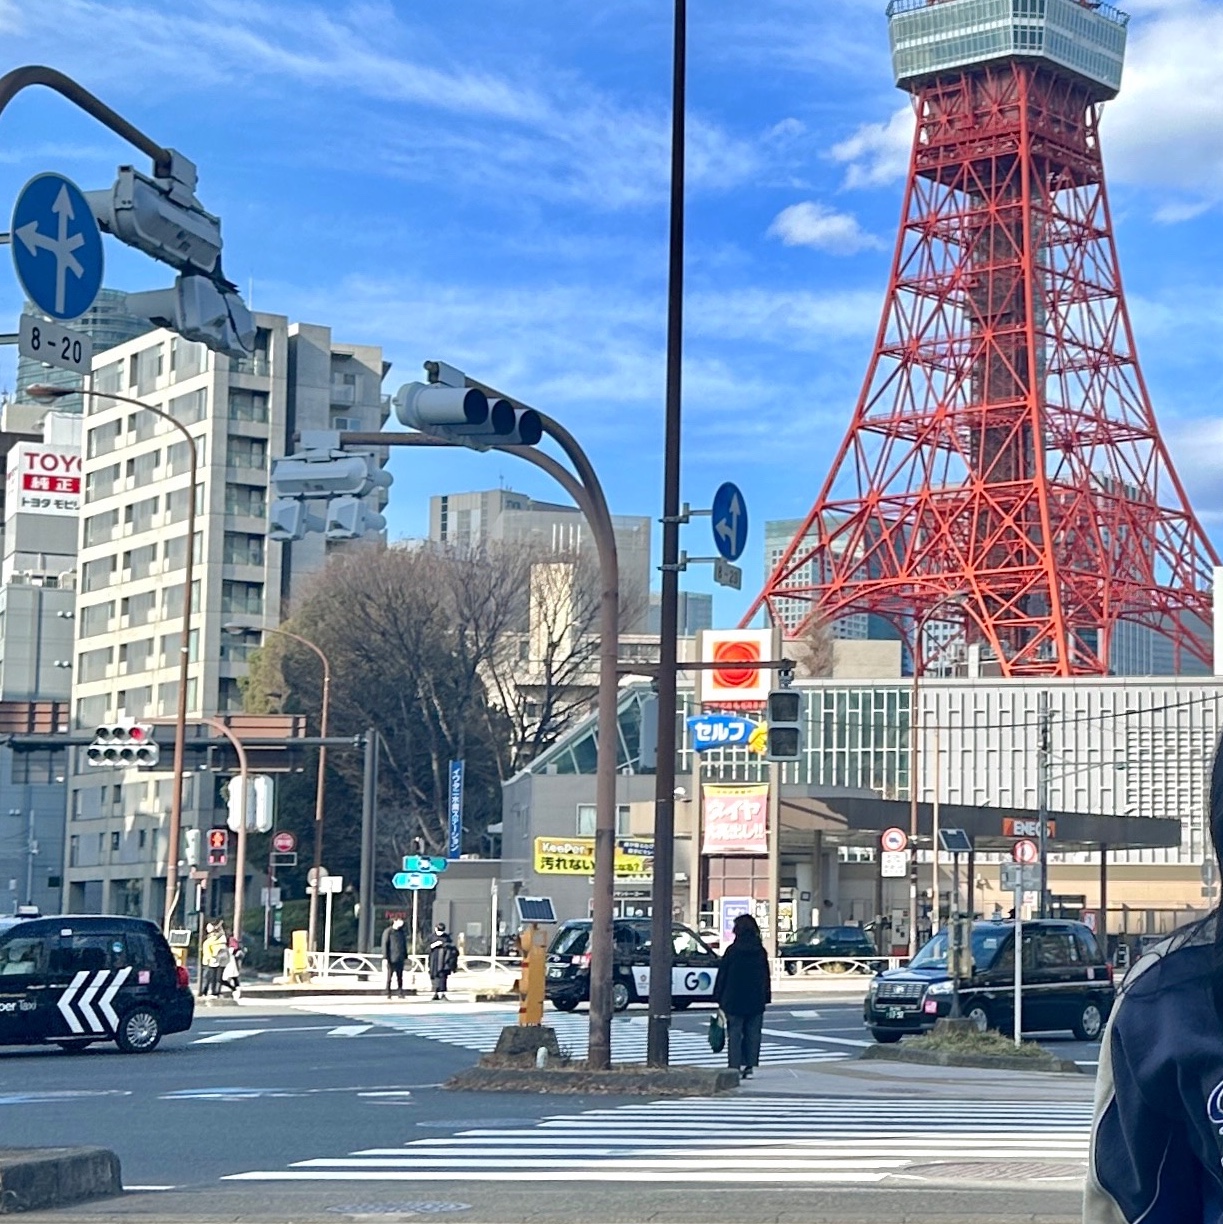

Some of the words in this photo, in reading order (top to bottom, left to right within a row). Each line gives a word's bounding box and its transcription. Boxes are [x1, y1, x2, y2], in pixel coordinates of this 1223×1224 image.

[31, 326, 82, 364] 8-20
[24, 452, 82, 473] TOY
[22, 497, 51, 508] トヨタ
[695, 722, 746, 742] セルフ
[684, 971, 712, 991] GO
